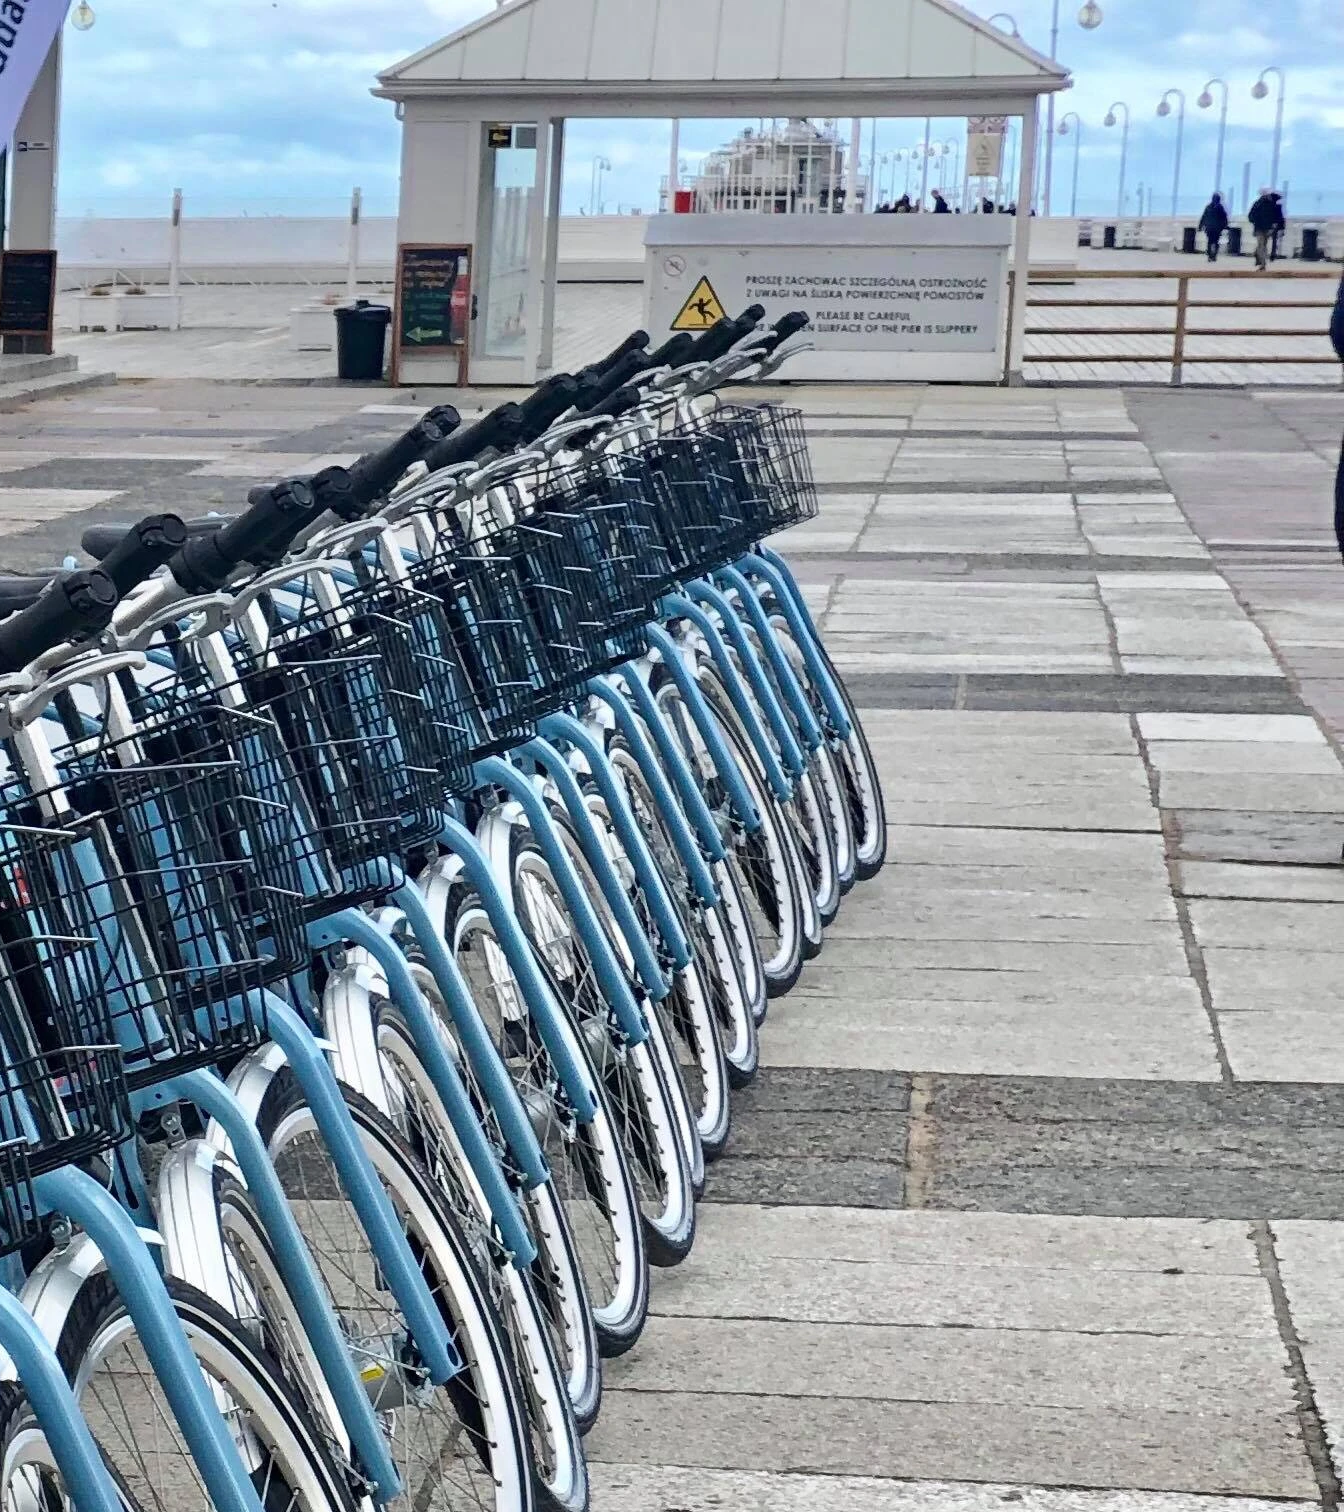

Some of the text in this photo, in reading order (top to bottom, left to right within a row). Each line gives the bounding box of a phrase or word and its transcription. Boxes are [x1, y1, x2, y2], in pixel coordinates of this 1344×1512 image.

[755, 289, 790, 298] UWAGI
[792, 290, 807, 298] NA
[815, 311, 911, 321] PLEASE BE CAREFUL
[817, 323, 861, 333] SURFACE
[864, 324, 878, 333] OF
[881, 324, 898, 333] THE
[901, 325, 921, 334] PIER
[923, 325, 933, 334] IS
[935, 325, 978, 334] SLIPPERY
